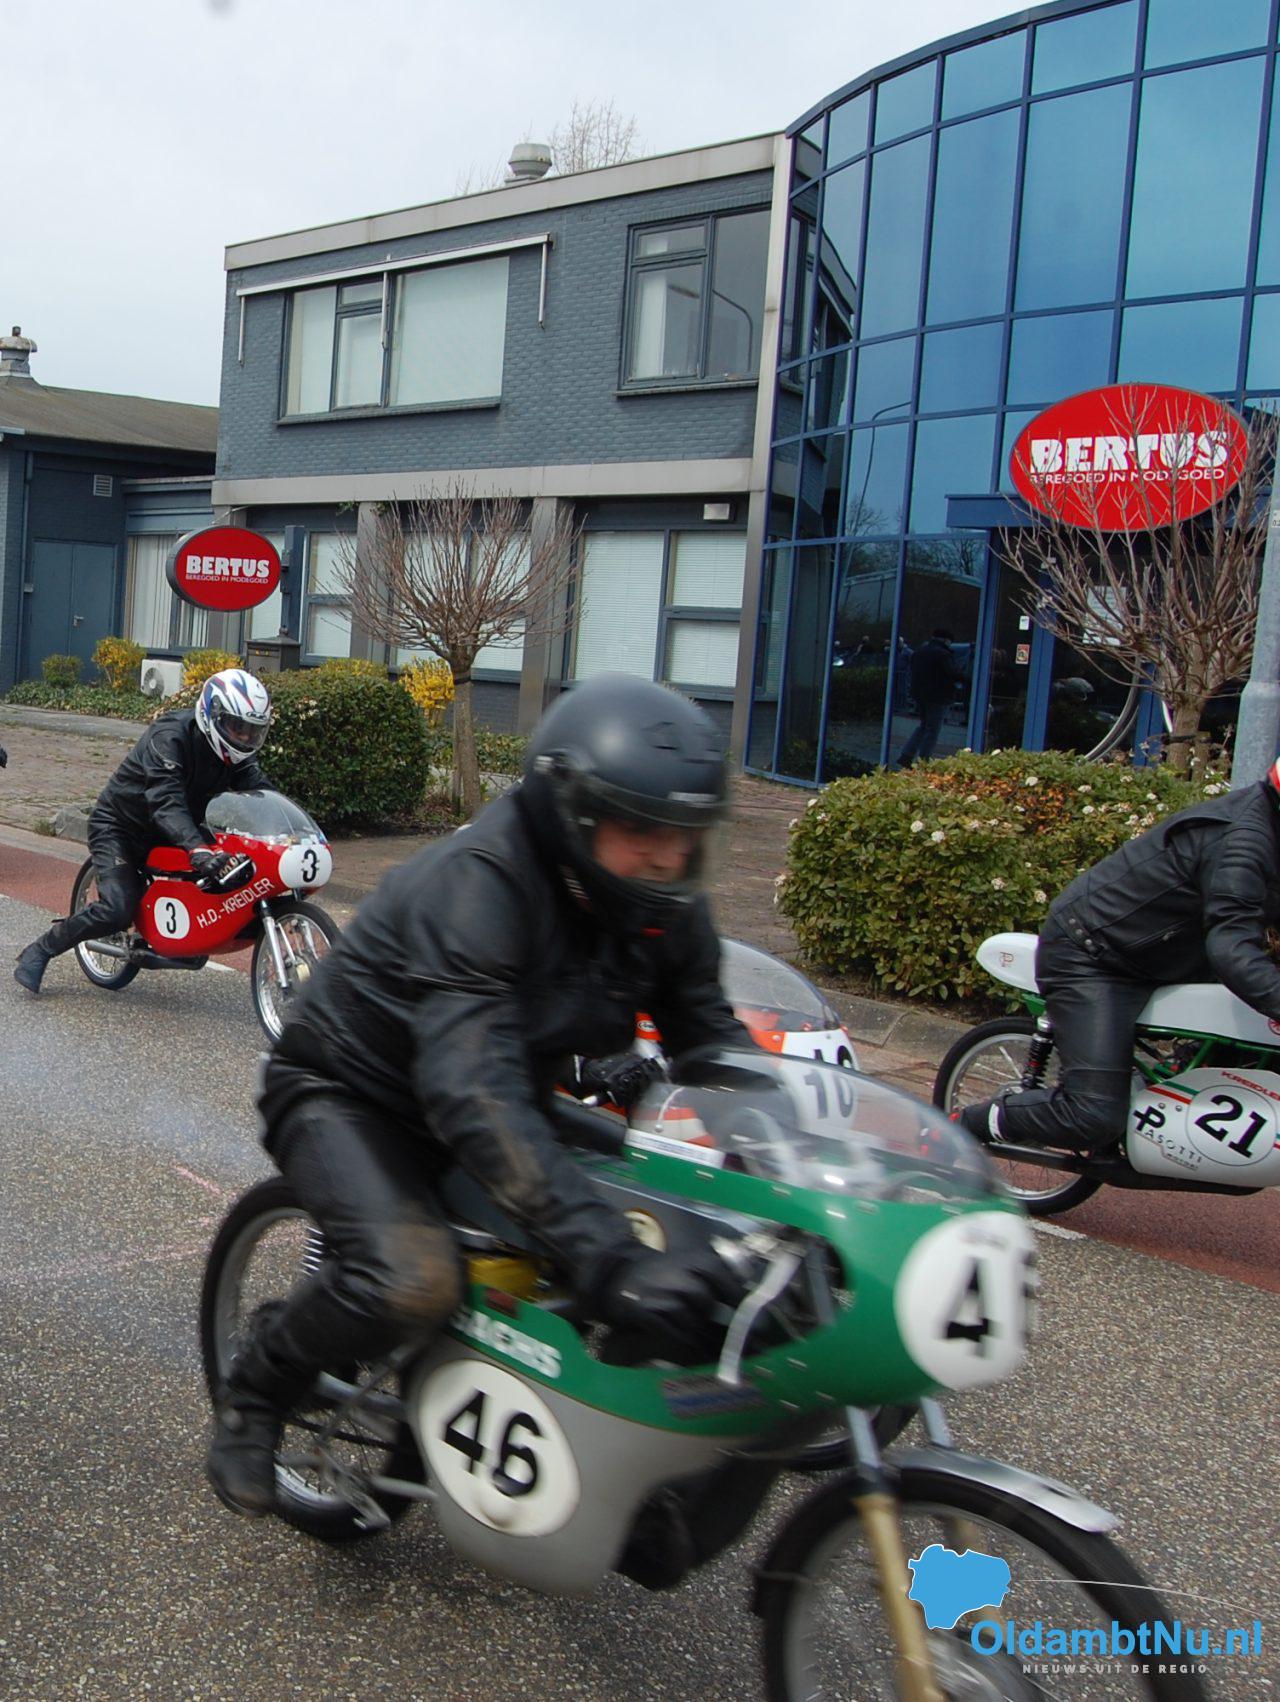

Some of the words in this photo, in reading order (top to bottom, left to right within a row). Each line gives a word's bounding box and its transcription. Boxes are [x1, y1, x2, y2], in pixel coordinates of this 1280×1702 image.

[1030, 431, 1228, 474] BERTUS
[1109, 472, 1126, 483] IN
[1130, 468, 1225, 483] MODGOED
[186, 555, 270, 578] BERTUS
[302, 849, 319, 883] 3
[166, 902, 177, 935] 3
[1194, 1094, 1268, 1159] 21
[443, 1388, 543, 1497] 46
